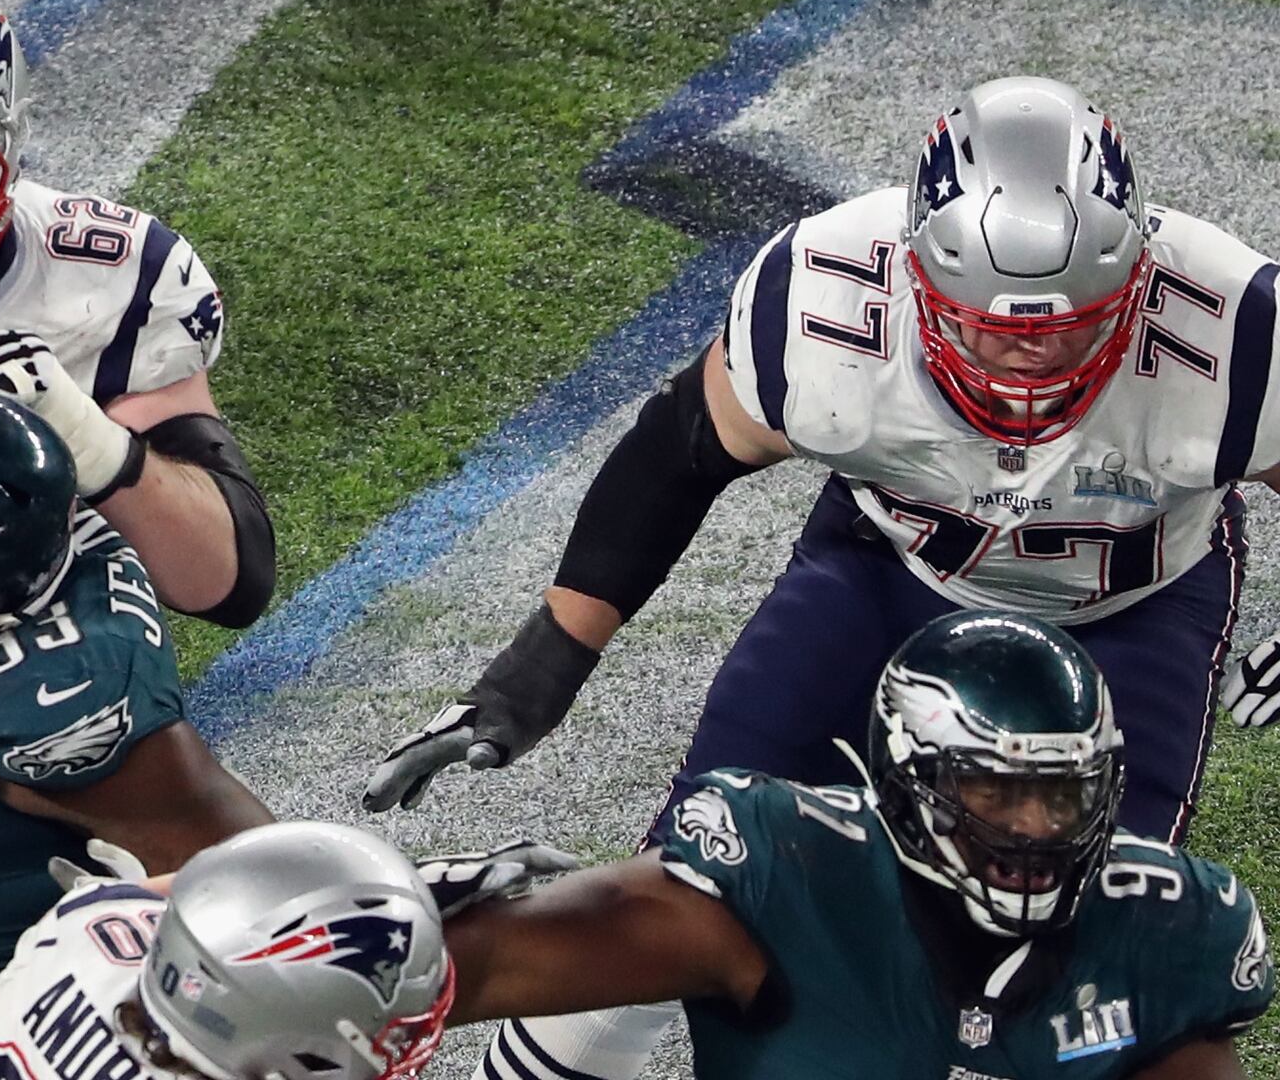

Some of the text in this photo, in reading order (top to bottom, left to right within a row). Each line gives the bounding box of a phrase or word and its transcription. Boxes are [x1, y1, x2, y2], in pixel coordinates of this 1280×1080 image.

[45, 197, 140, 267] 62
[801, 239, 897, 361] 77
[1135, 261, 1226, 382] 77
[868, 480, 1168, 611] 77
[974, 492, 1053, 511] PATRIOTS
[1101, 834, 1183, 902] 91
